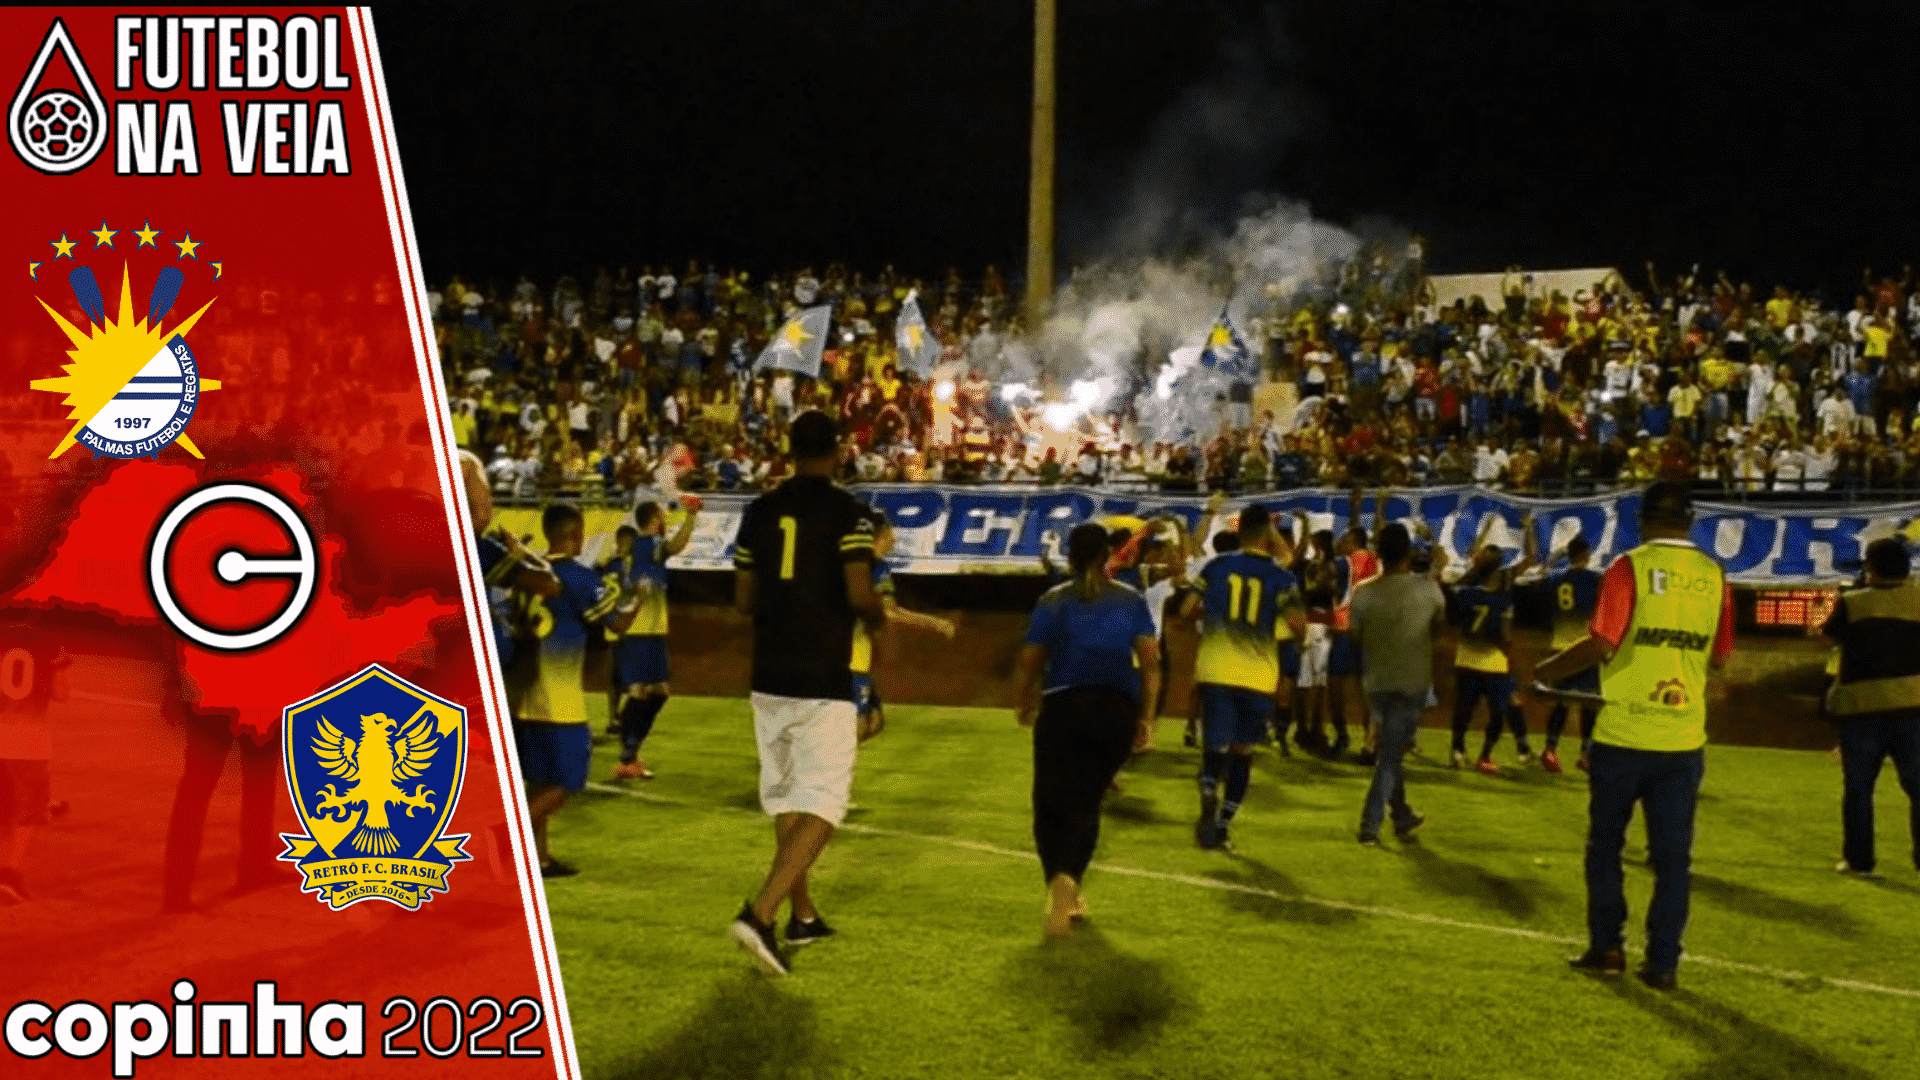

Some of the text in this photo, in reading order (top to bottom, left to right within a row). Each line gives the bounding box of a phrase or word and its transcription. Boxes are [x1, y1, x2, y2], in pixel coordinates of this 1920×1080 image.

[779, 515, 797, 580] 1
[1228, 573, 1261, 625] 11
[1557, 582, 1575, 611] 8
[1472, 604, 1490, 633] 7
